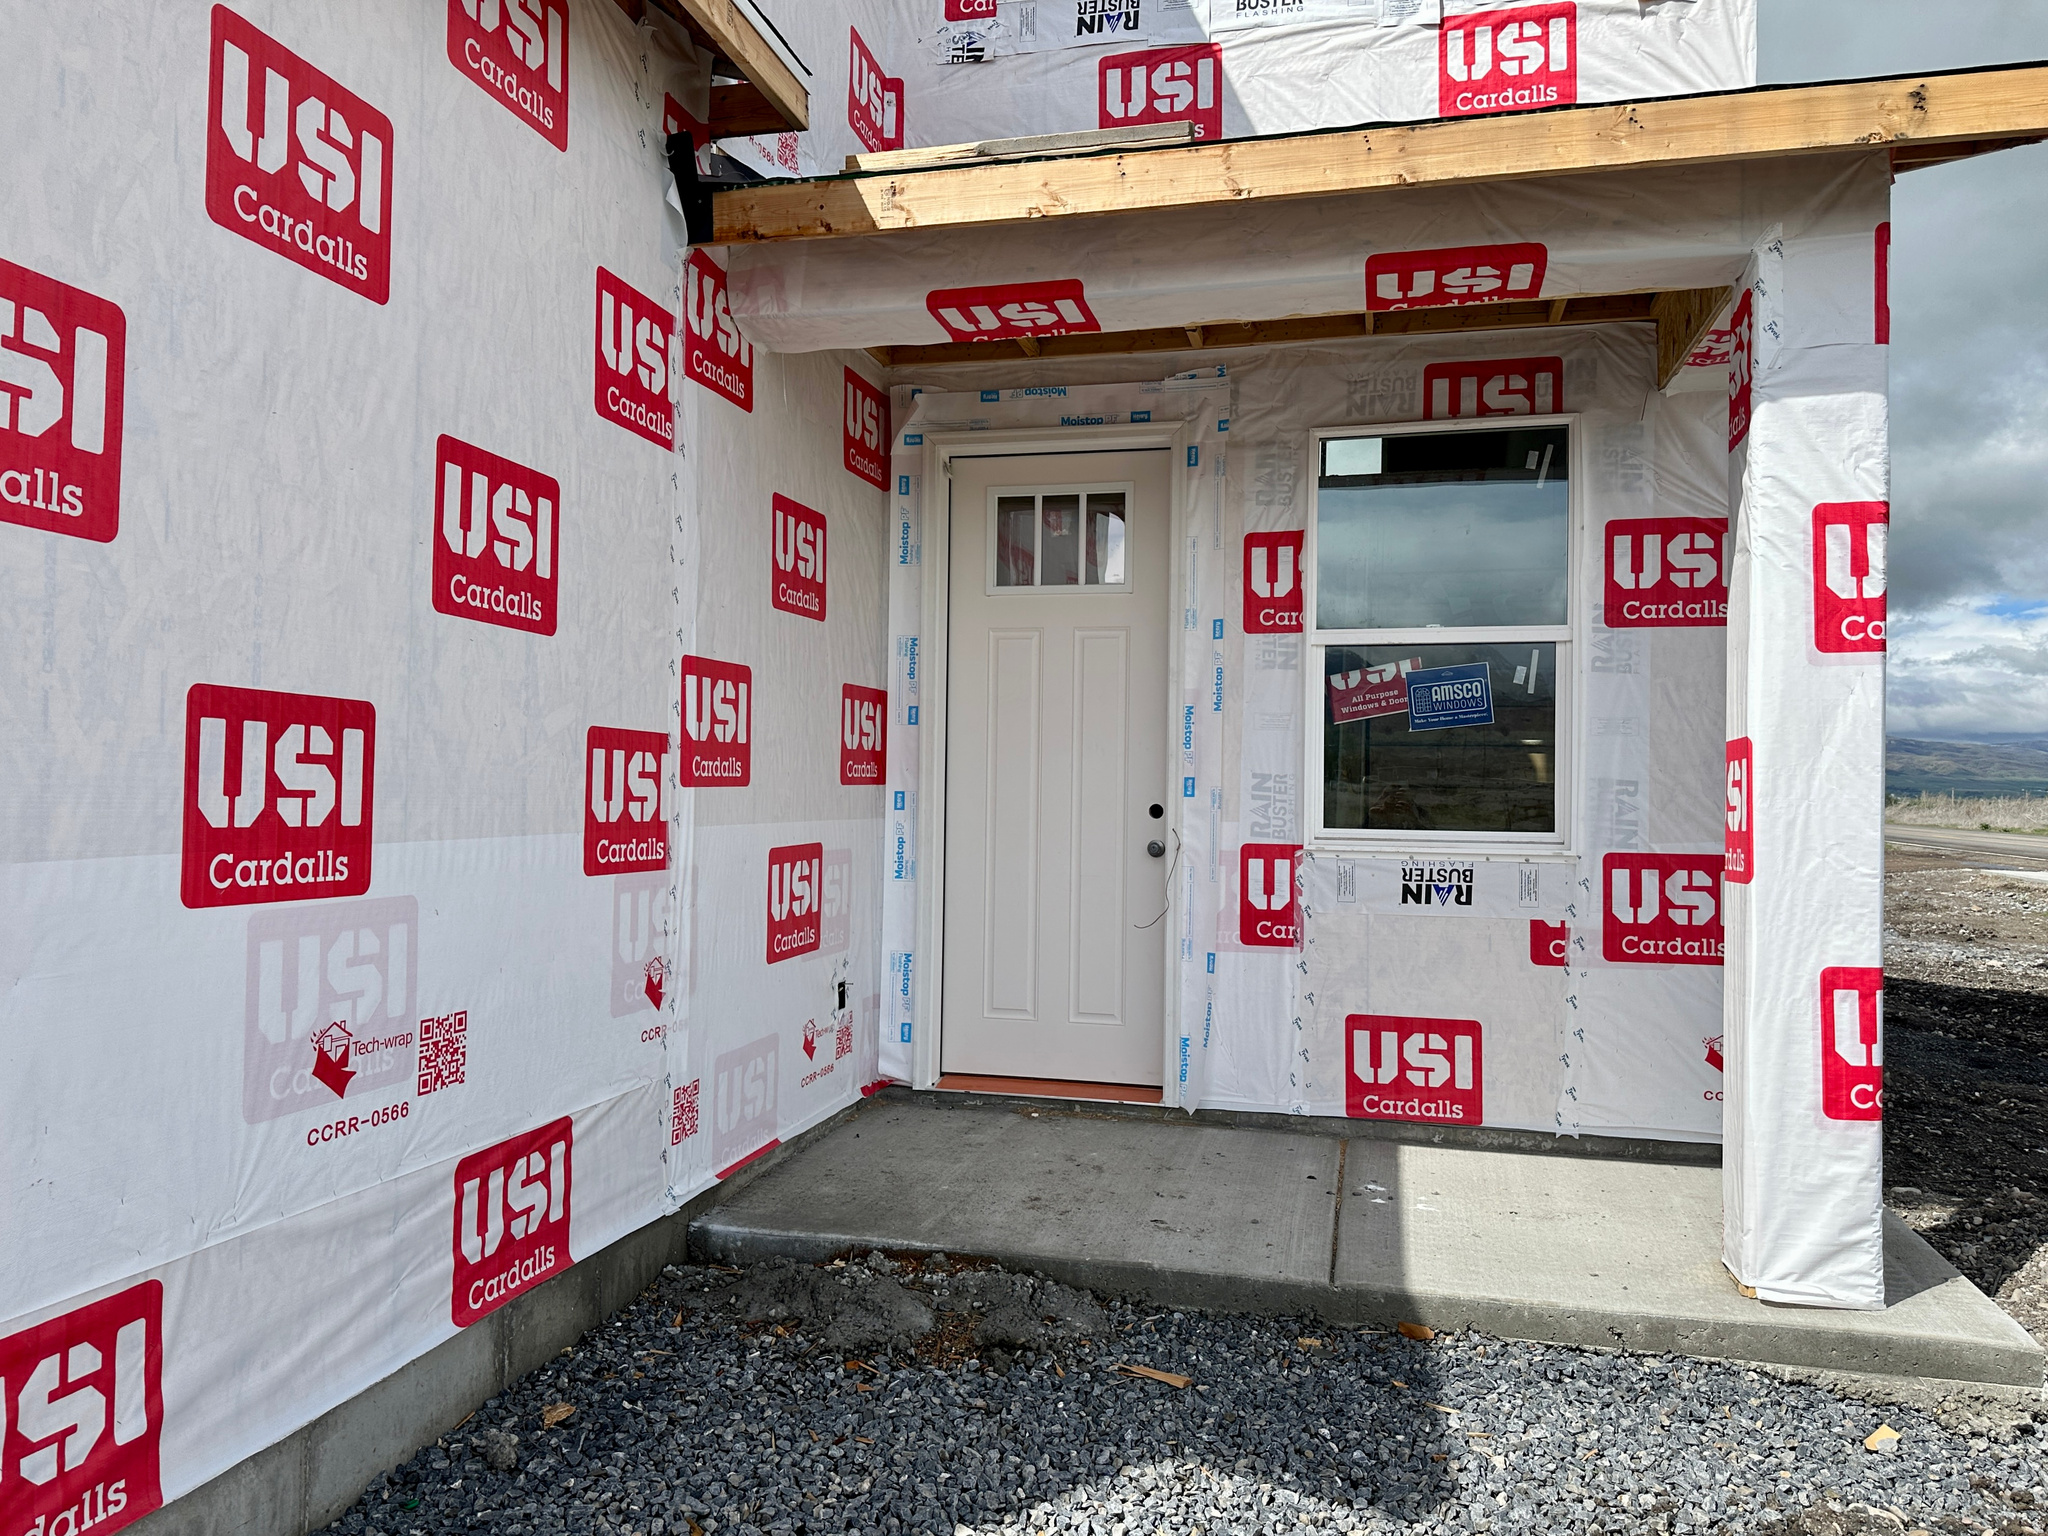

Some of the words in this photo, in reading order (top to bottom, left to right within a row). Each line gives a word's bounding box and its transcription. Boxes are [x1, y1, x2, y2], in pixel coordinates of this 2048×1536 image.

[1077, 10, 1140, 36] RAIN
[1236, 6, 1304, 18] FLASHING
[461, 0, 562, 93] SI
[1447, 17, 1568, 82] USI
[465, 37, 553, 129] Cardalls
[852, 42, 897, 139] USI
[1106, 57, 1214, 119] USI
[1456, 83, 1557, 111] Cardalls
[221, 39, 383, 234] USI
[233, 184, 368, 281] Cardalls
[1376, 263, 1534, 300] USI
[1754, 279, 1767, 298] Tyvek
[687, 262, 750, 368] USI
[938, 299, 1086, 332] USI
[1767, 322, 1780, 341] Tyvek
[601, 290, 675, 404] USI
[693, 349, 745, 399] Cardalls
[1024, 386, 1067, 397] Moistop
[1432, 372, 1553, 419] USI
[607, 387, 672, 441] Cardalls
[847, 381, 885, 456] USI
[1061, 414, 1104, 427] Moistop
[849, 448, 882, 482] Cardalls
[443, 461, 552, 579] USI
[775, 508, 824, 586] USI
[899, 522, 911, 565] Moistop
[450, 575, 542, 622] Cardalls
[779, 581, 820, 615] Cardalls
[1623, 600, 1728, 619] Cardalls
[907, 637, 918, 680] Moistop
[685, 674, 748, 744] USI
[1213, 667, 1222, 712] Moistop
[1341, 701, 1379, 714] Windows
[1352, 695, 1364, 703] All
[1365, 689, 1399, 702] Purpose
[1432, 683, 1482, 702] AMSCO
[1433, 697, 1484, 711] WINDOWS
[843, 697, 882, 752] USI
[1183, 705, 1194, 750] Moistop
[198, 717, 364, 829] USI
[592, 748, 670, 823] USI
[692, 755, 742, 779] Cardalls
[847, 757, 878, 778] Cardalls
[1250, 772, 1272, 838] RAIN
[1272, 773, 1288, 840] BUSTER
[1615, 779, 1639, 850] RAIN
[1725, 758, 1747, 832] SI
[209, 850, 348, 889] Cardalls
[597, 838, 664, 864] Cardalls
[894, 837, 905, 880] Moistop
[771, 858, 819, 922] USI
[1401, 867, 1474, 883] BUSTER
[1401, 883, 1473, 906] RAIN
[773, 926, 816, 953] Cardalls
[258, 922, 408, 1045] USI
[901, 953, 912, 996] Moistop
[352, 1032, 413, 1057] Tech-wrap
[1203, 1001, 1212, 1048] Moistop
[1180, 1036, 1190, 1082] Moistop
[1353, 1029, 1473, 1090] USI
[716, 1051, 776, 1136] USI
[1363, 1096, 1463, 1119] Cardalls
[307, 1101, 410, 1146] CCRR-0566
[461, 1139, 566, 1266] USI
[469, 1247, 556, 1310] Cardalls
[0, 1318, 148, 1486] SI
